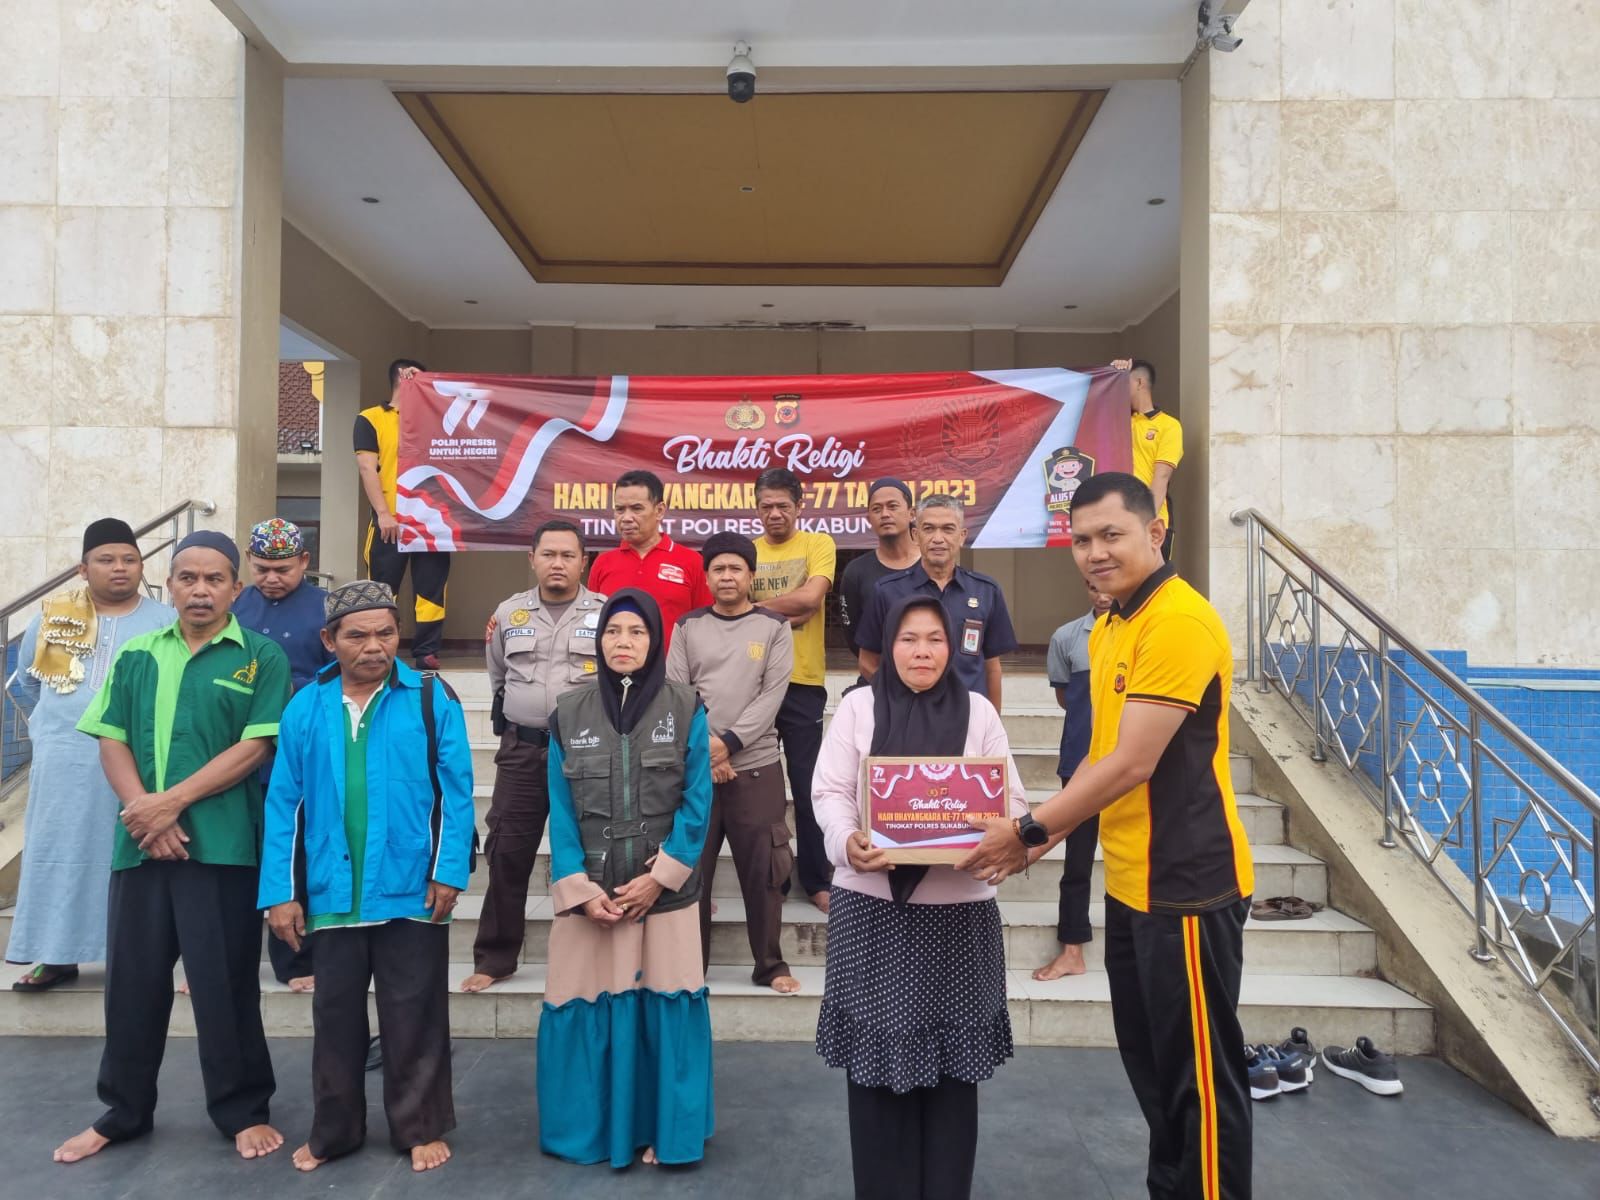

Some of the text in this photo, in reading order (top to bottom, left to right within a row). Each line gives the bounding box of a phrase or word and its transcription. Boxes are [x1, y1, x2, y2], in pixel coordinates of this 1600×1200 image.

[431, 438, 496, 446] POLRI PRESISI
[429, 447, 497, 456] UNTUK NEGERI
[663, 433, 866, 479] Bhakti Religi
[553, 483, 607, 510] HARI
[681, 518, 765, 535] POLRES
[767, 576, 789, 591] NEW
[909, 798, 968, 811] Bhakti Religi
[877, 812, 893, 821] HARI
[894, 812, 941, 821] BHAYANGKARA
[942, 812, 961, 821] KE-77
